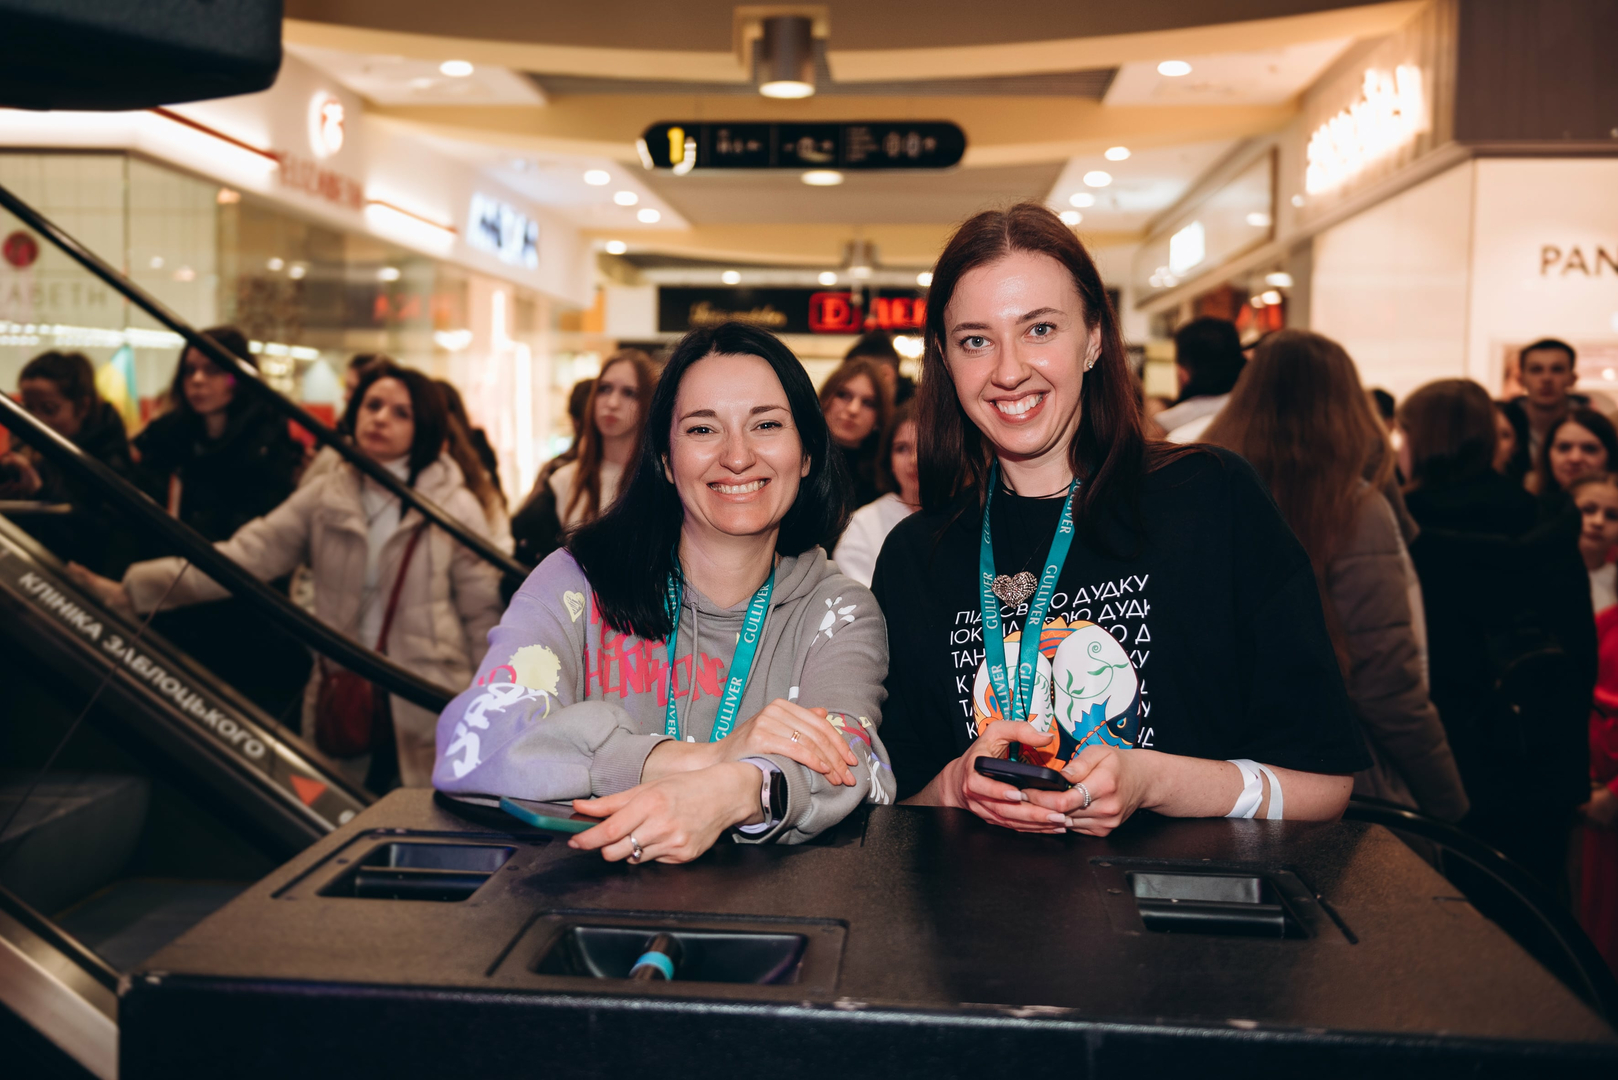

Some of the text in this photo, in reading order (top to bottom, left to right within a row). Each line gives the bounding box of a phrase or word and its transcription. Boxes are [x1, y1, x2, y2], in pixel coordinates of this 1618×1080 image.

[1540, 244, 1618, 276] PAN
[0, 282, 108, 310] ABETH
[744, 584, 770, 644] GULLIVER
[983, 572, 998, 629] GULLIVER
[1028, 564, 1058, 626] GULLIVER
[1072, 574, 1149, 608] ДУДКУ
[18, 571, 266, 759] КЛІНІКА ЗАБЛОЦЬКОГО
[991, 664, 1011, 721] ULLIVER
[715, 676, 743, 741] GULLIVER
